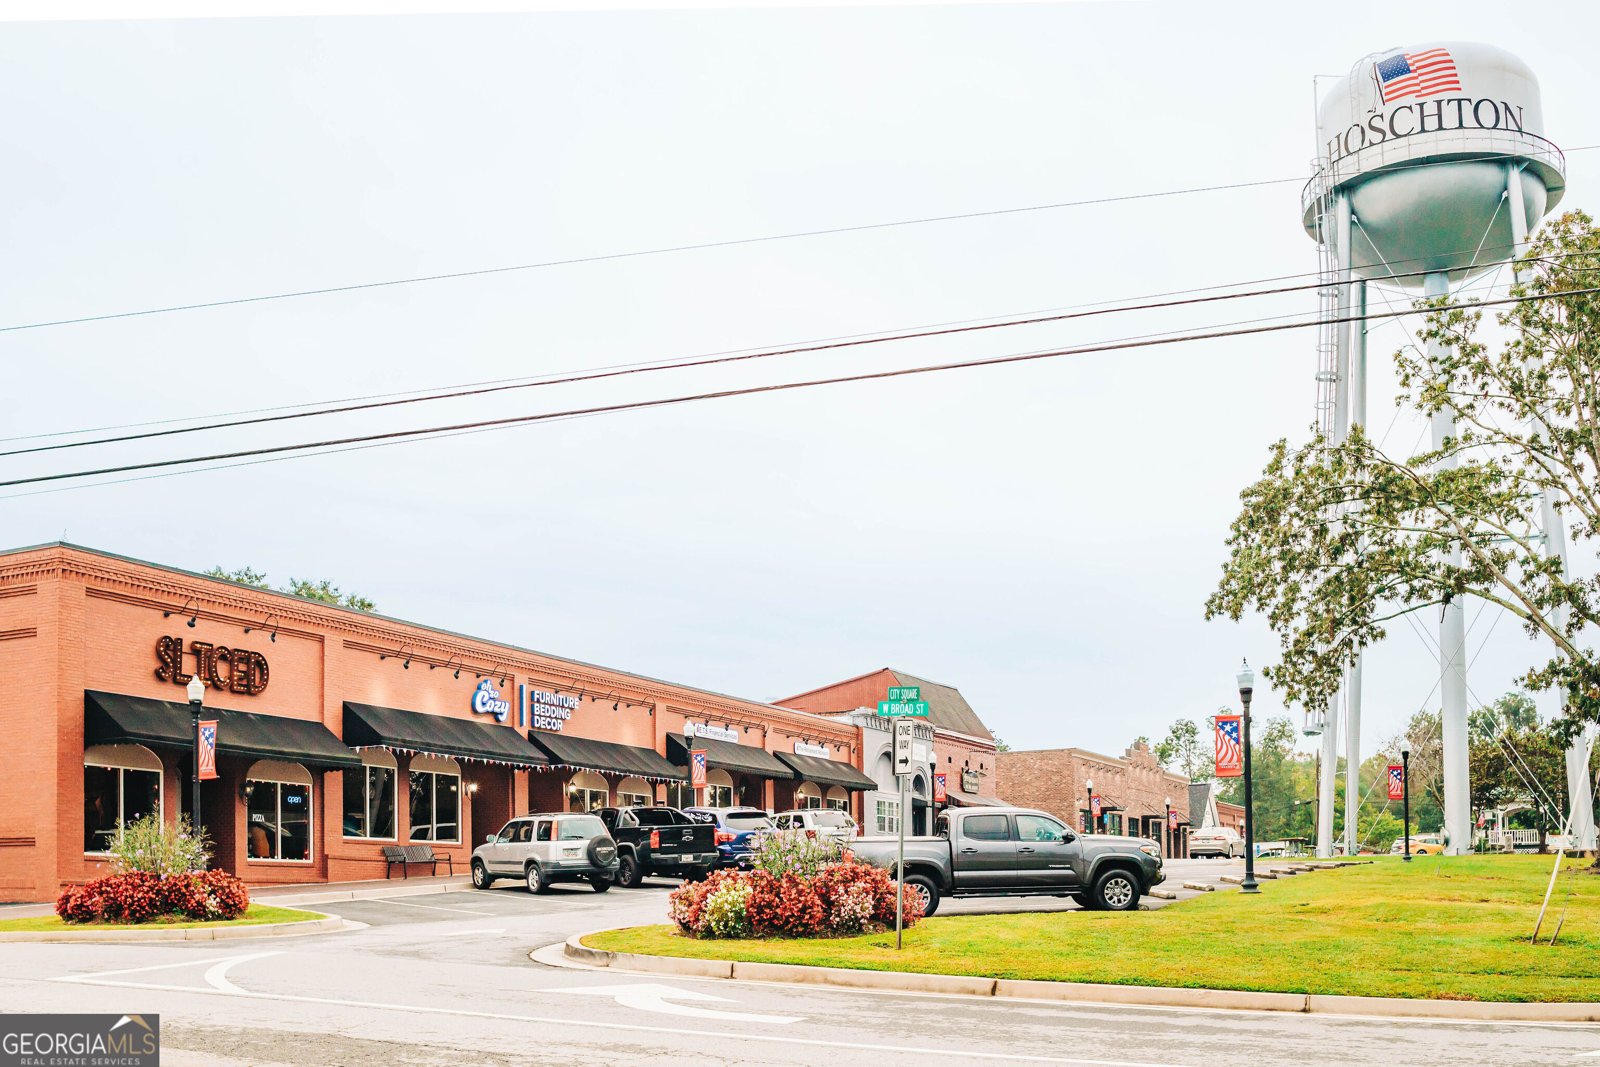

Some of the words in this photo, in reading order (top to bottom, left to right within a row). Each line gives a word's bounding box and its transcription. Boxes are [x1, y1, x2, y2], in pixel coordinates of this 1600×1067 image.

[1327, 98, 1524, 162] HOSCHTON
[155, 635, 269, 695] SLICED
[481, 680, 492, 692] oh
[534, 691, 580, 709] FURNITURE
[890, 689, 900, 699] CITY
[900, 689, 918, 699] SQUARE
[475, 690, 509, 722] Cozy
[534, 704, 571, 719] BEDDING
[882, 704, 889, 714] W
[890, 704, 914, 714] BROAD
[916, 704, 924, 714] ST
[534, 715, 563, 731] DECOR
[898, 725, 911, 736] ONE
[899, 740, 910, 750] WAY
[287, 796, 302, 804] open
[252, 813, 265, 822] PIZZA
